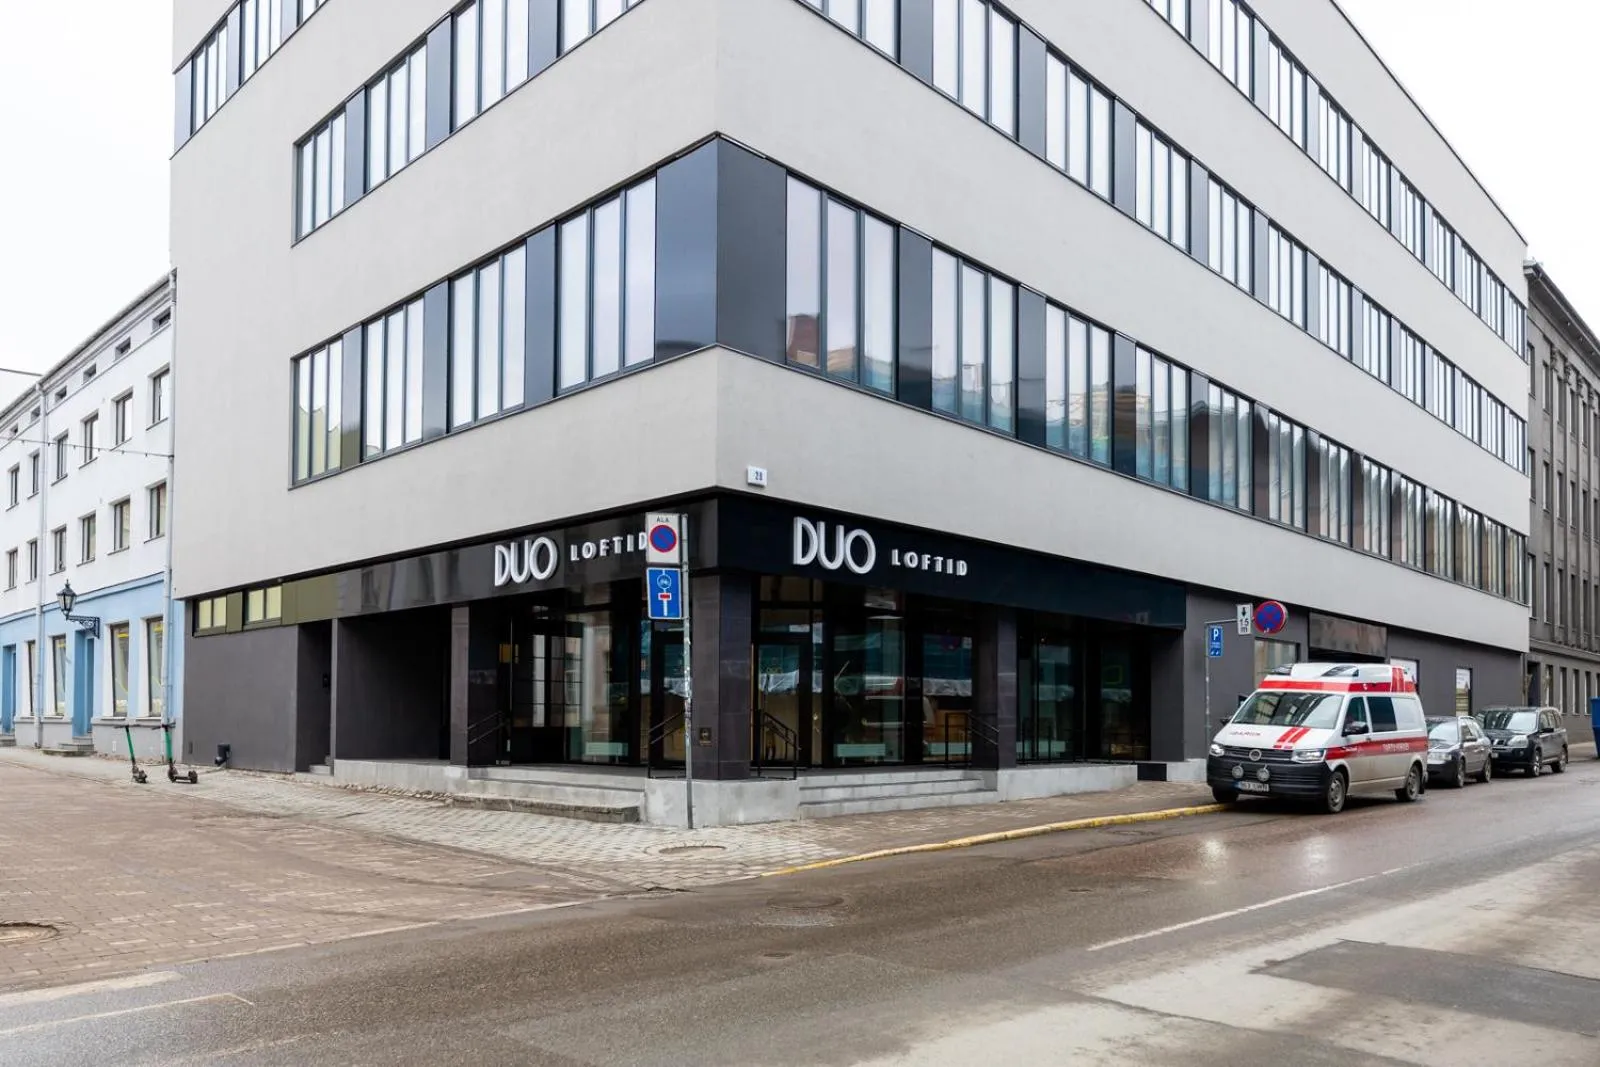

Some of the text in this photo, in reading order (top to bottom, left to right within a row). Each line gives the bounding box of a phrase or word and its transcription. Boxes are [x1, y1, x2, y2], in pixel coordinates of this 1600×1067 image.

[494, 531, 648, 587] DUO LOFTID
[793, 516, 968, 576] DUO LOFTID
[1213, 628, 1220, 641] P
